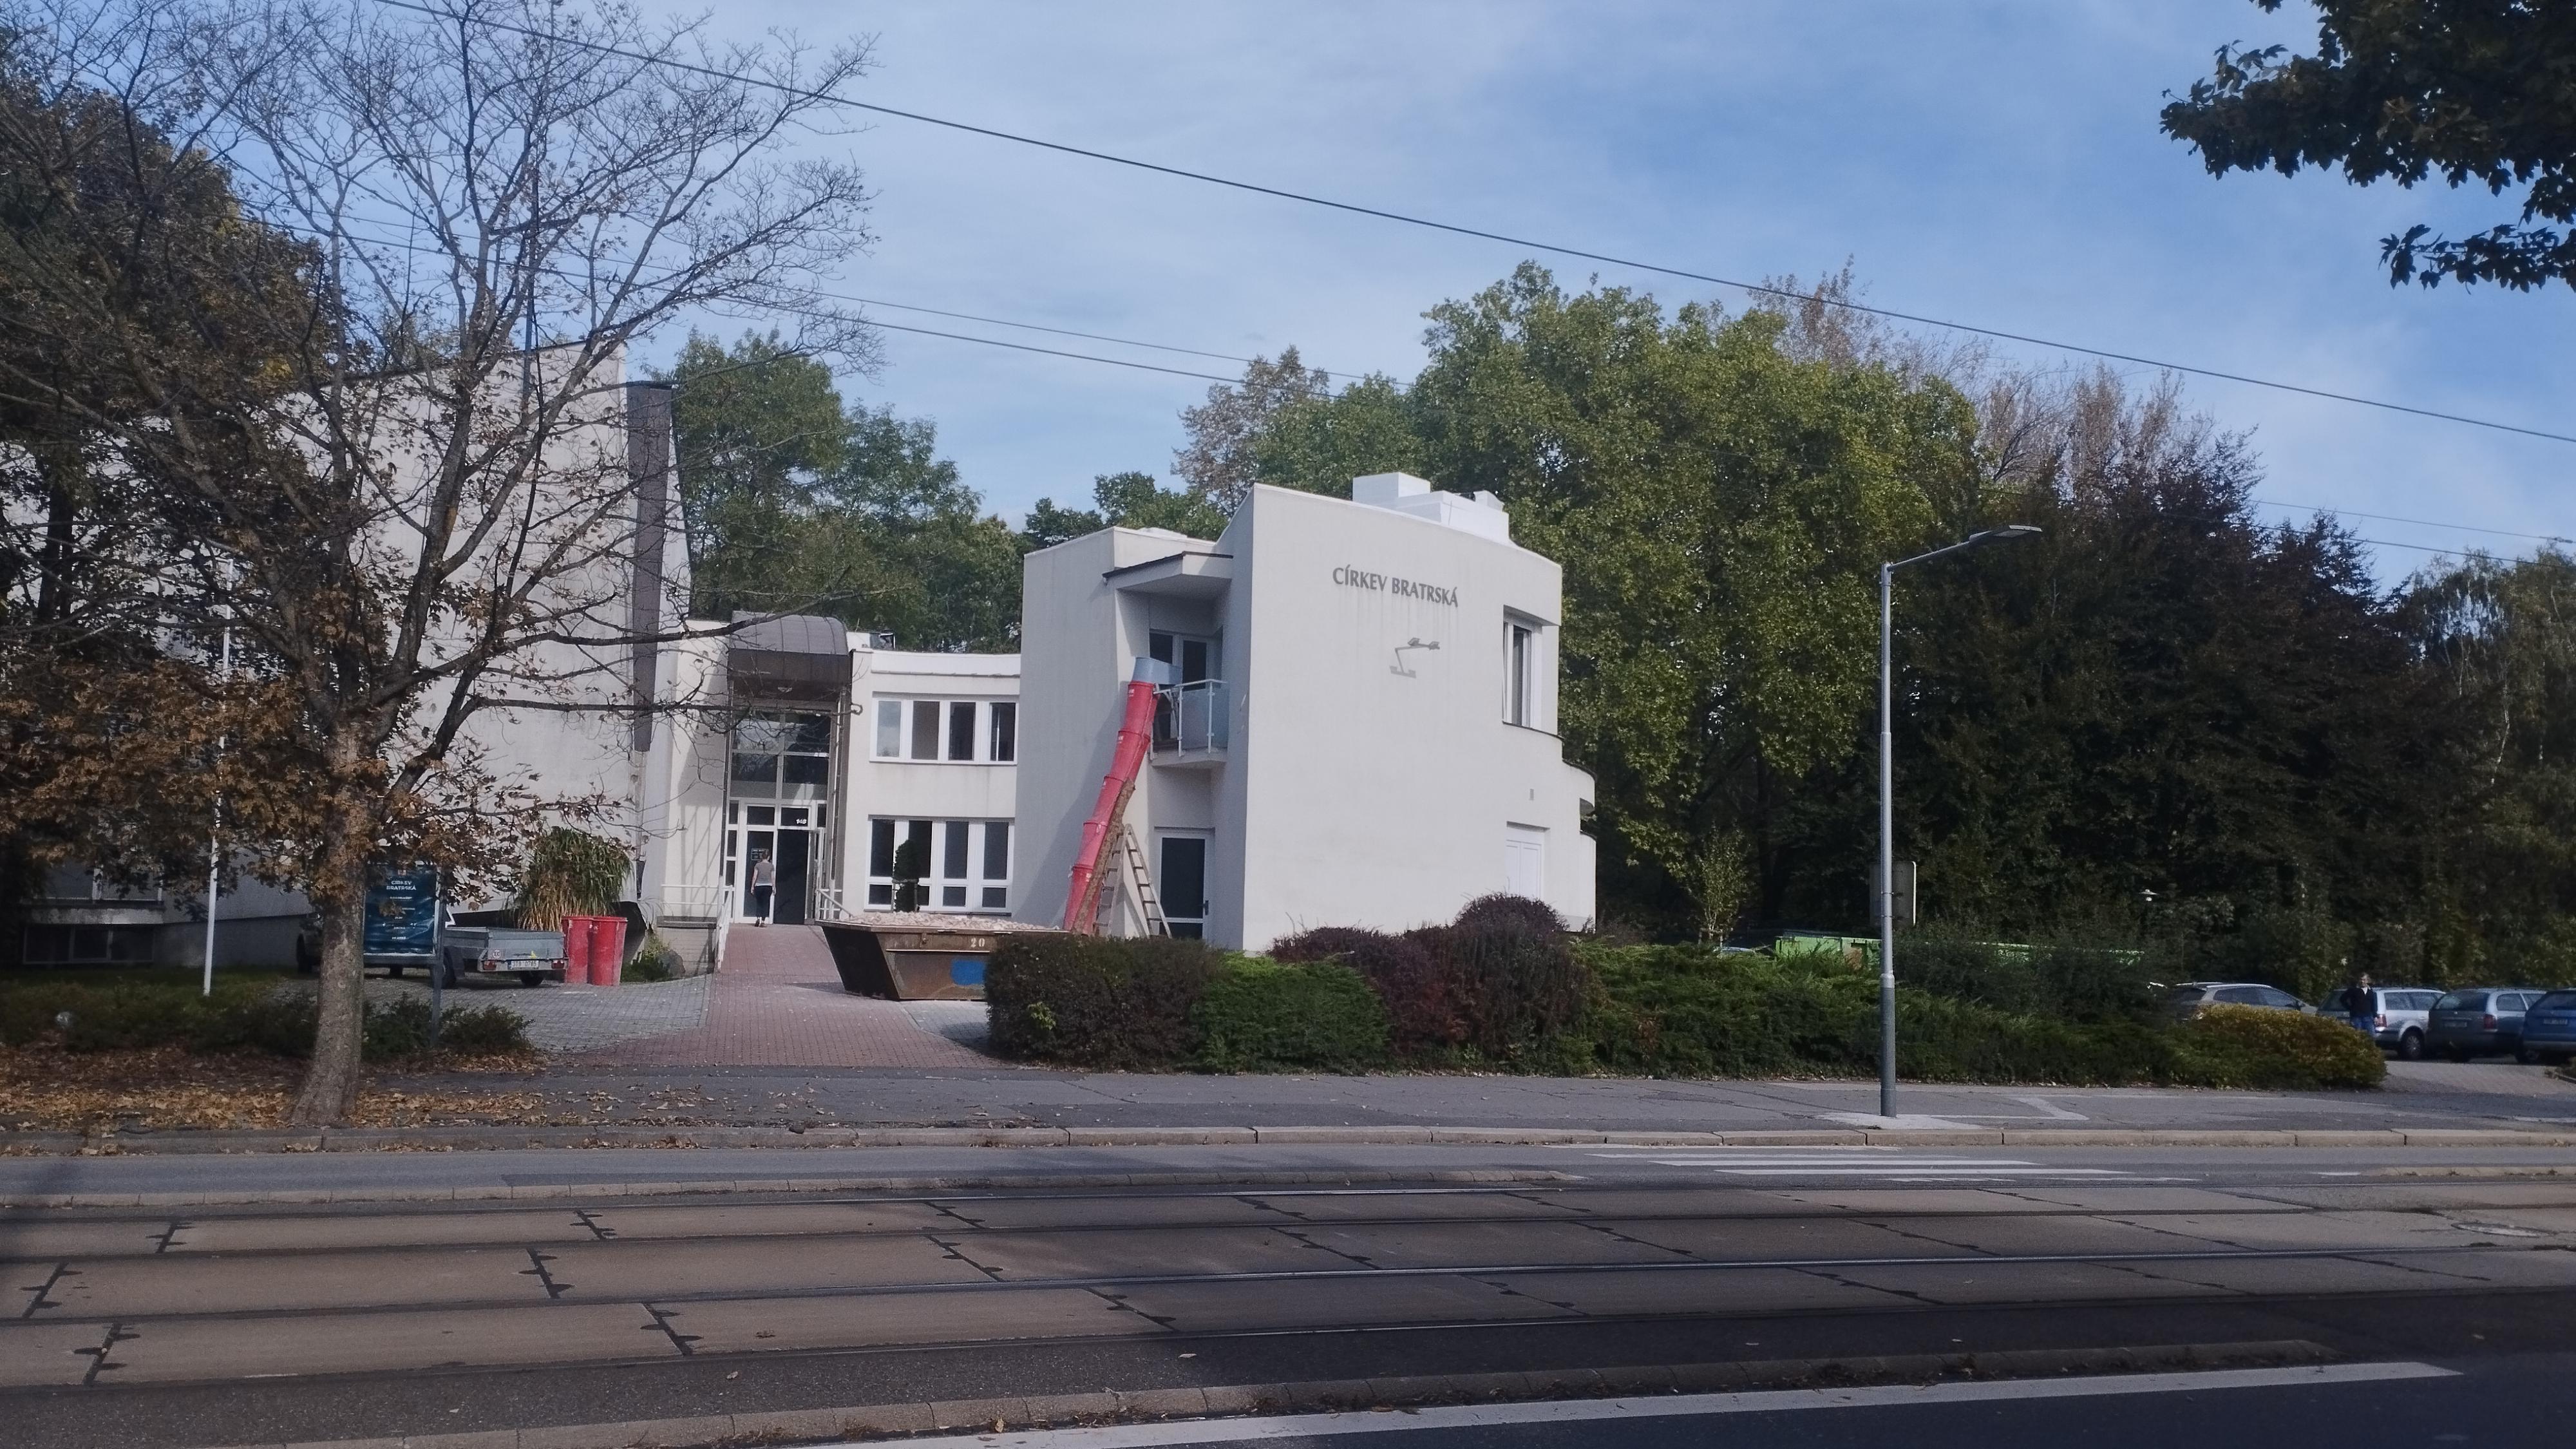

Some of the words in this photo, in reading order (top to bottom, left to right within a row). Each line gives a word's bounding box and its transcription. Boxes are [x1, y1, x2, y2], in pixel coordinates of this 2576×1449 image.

[1332, 564, 1388, 592] CÍRKEV
[1392, 577, 1458, 607] BRATRSKÁ
[971, 937, 985, 947] 20
